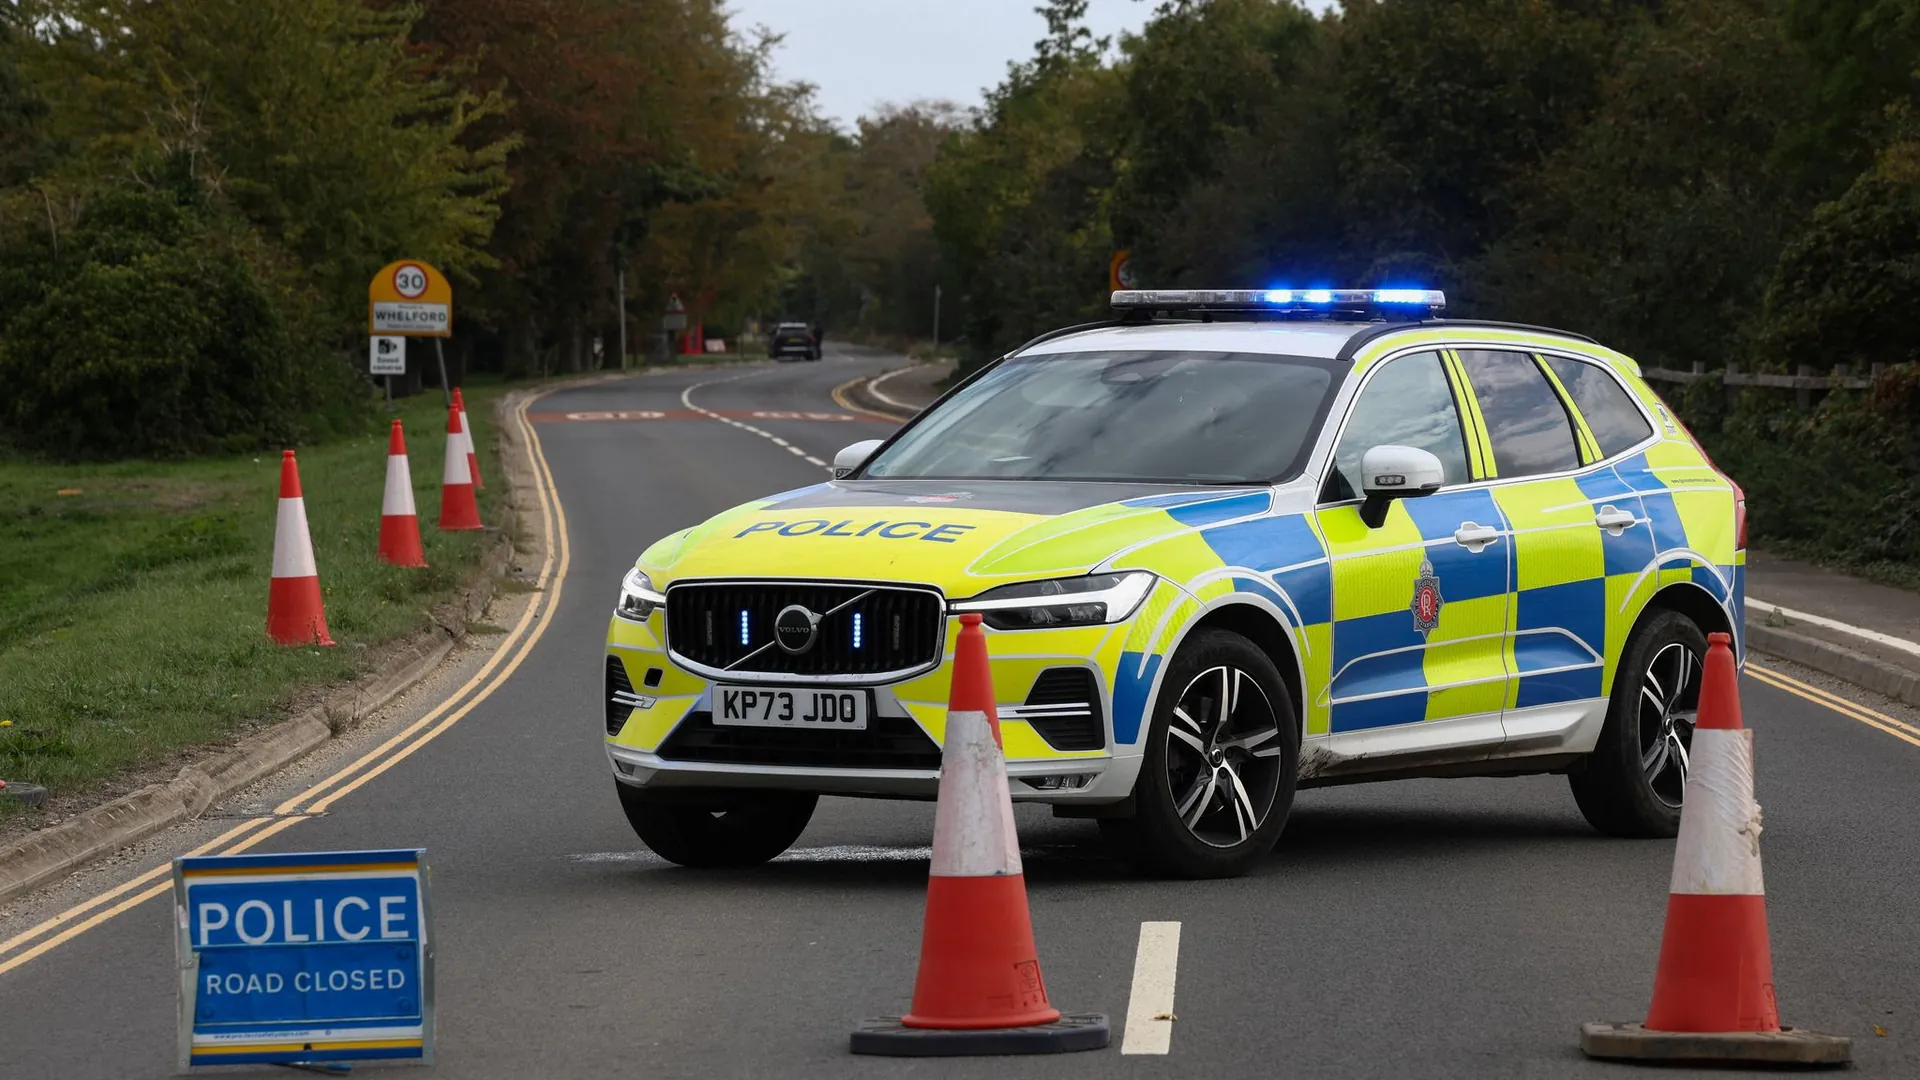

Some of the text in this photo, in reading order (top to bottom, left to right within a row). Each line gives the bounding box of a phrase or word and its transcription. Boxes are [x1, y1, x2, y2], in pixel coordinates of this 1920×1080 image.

[398, 273, 424, 289] 30
[375, 311, 446, 322] WHELFORD
[734, 519, 977, 543] POLICE
[723, 690, 856, 723] KP73 JDO
[198, 896, 409, 946] POLICE
[206, 969, 405, 995] ROAD CLOSED
